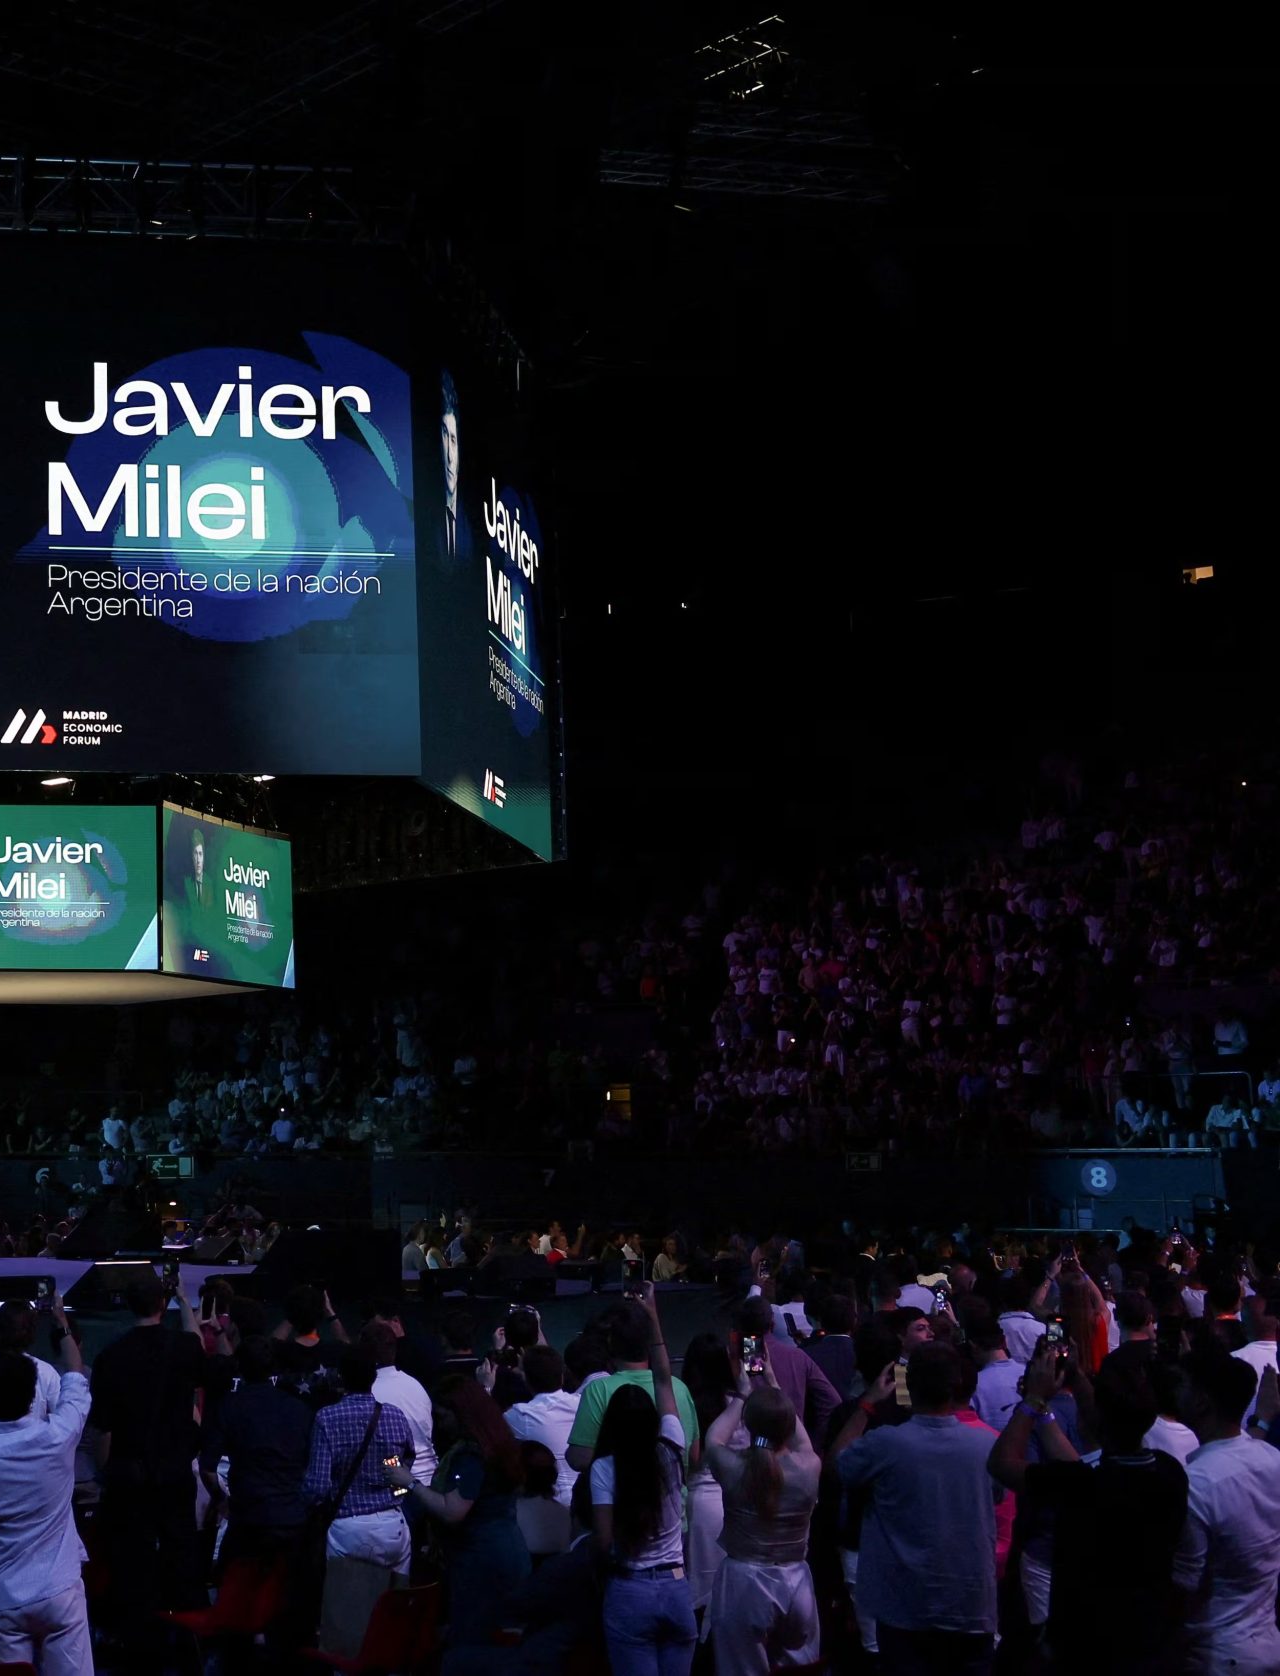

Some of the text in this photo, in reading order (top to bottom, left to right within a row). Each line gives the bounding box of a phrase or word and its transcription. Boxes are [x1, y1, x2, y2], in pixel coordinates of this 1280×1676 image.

[45, 362, 371, 439] Javier
[48, 462, 265, 539] Milei
[484, 476, 539, 585] Javier
[47, 564, 382, 595] Presidente de la nación
[47, 592, 194, 621] Argentina
[486, 555, 526, 656] Milei
[63, 711, 108, 720] MADRID
[63, 723, 123, 733] ECONOMIC
[63, 736, 101, 745] FORUM
[224, 857, 270, 889] Javier
[46, 908, 60, 918] de
[61, 908, 69, 918] la
[71, 909, 105, 918] nación
[225, 890, 257, 919] Milei
[1091, 1167, 1107, 1187] 8
